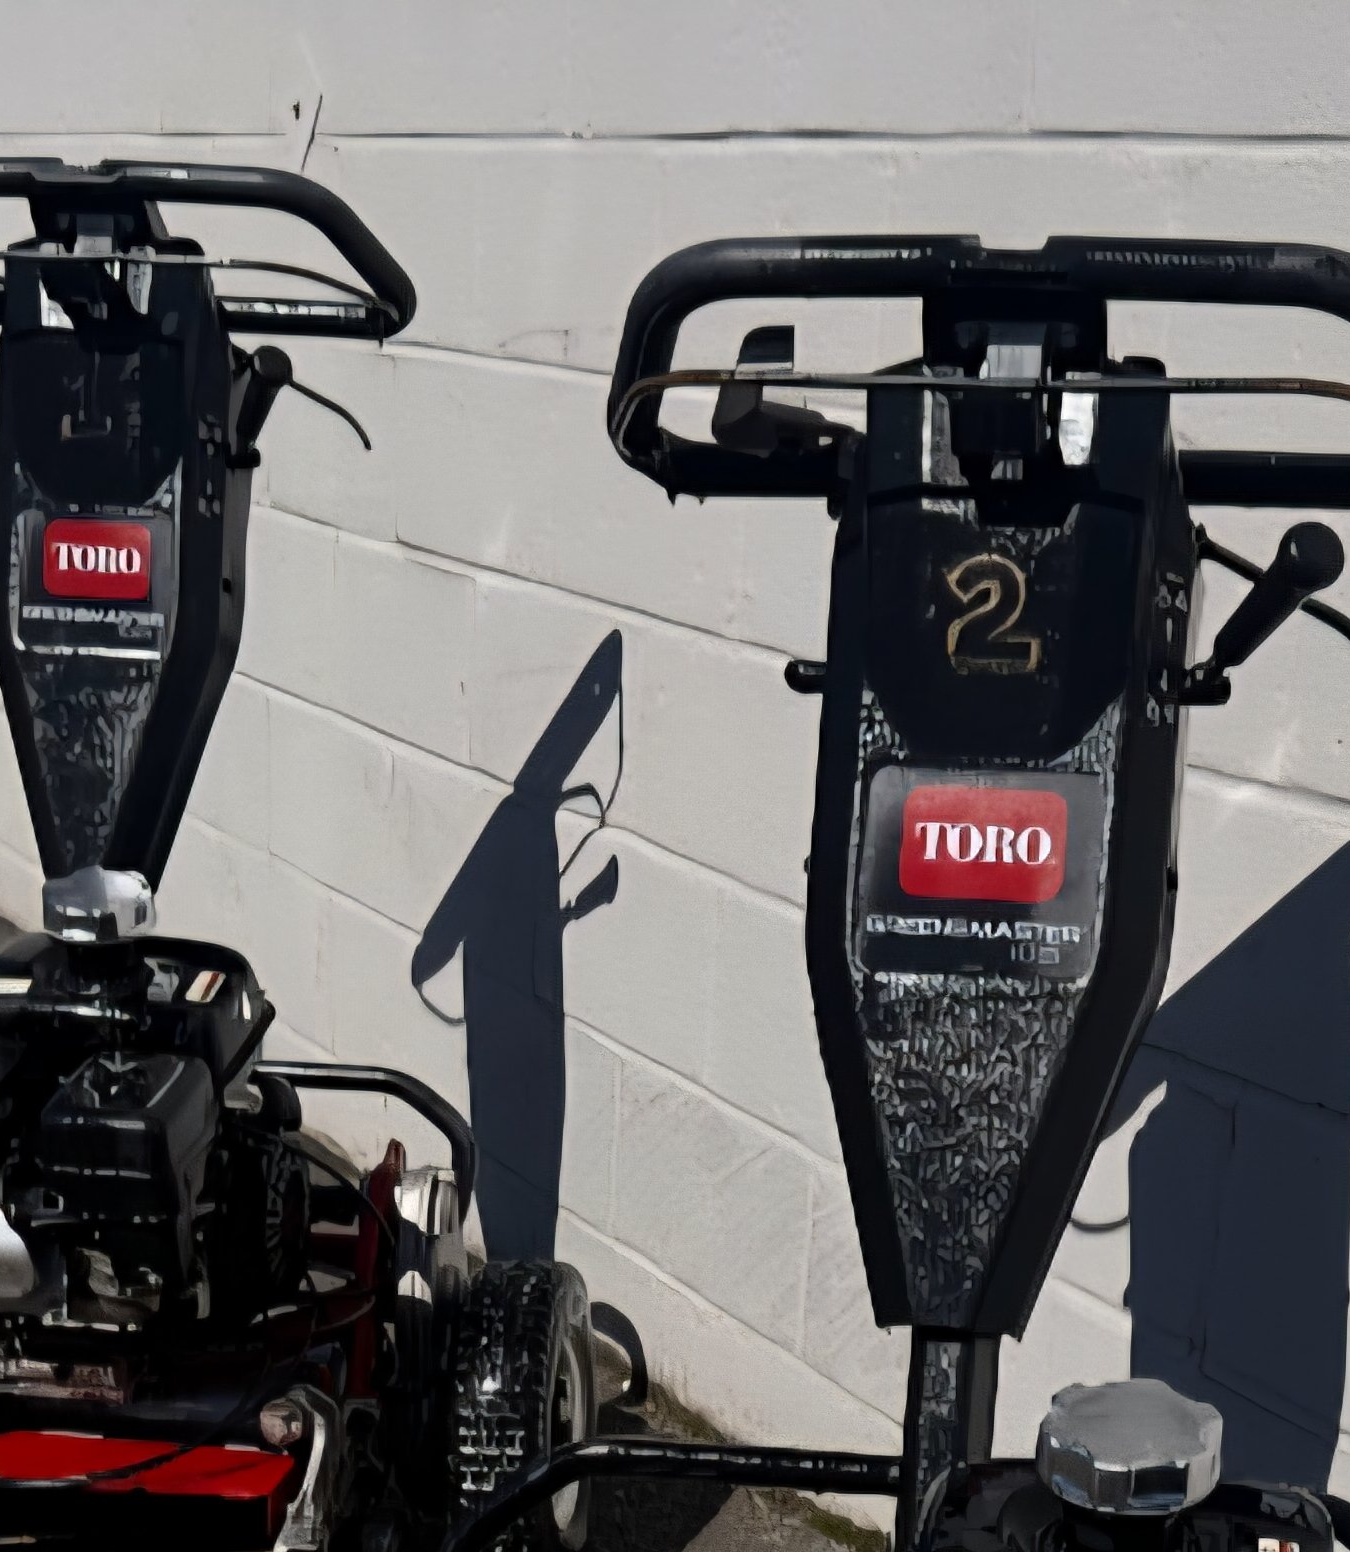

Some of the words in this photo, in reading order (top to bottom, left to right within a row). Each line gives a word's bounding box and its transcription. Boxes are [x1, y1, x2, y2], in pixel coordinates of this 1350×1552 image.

[52, 542, 141, 574] TORO
[947, 553, 1041, 675] 2
[915, 822, 1052, 865] TORO
